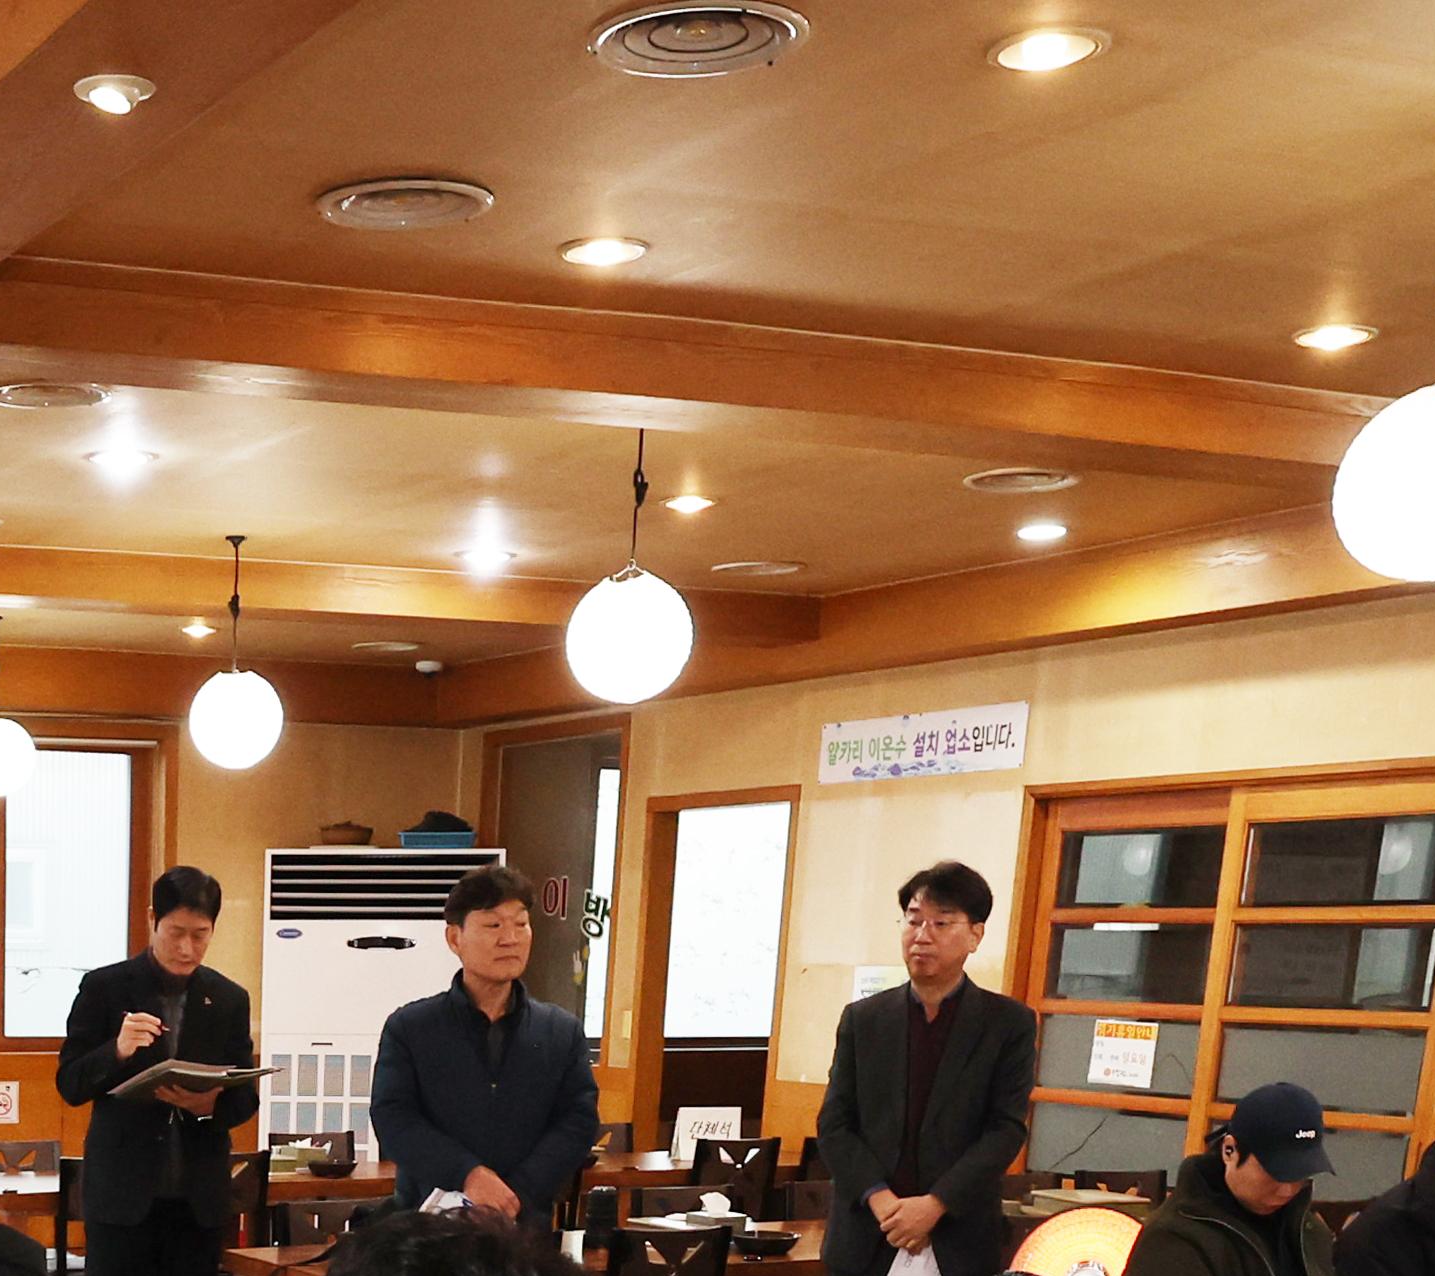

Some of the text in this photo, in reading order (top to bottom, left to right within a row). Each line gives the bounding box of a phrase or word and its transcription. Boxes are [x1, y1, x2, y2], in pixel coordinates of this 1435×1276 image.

[828, 722, 1016, 765] 알카리 이온수 설치 업소입니다.
[1295, 1129, 1316, 1140] Jeep
